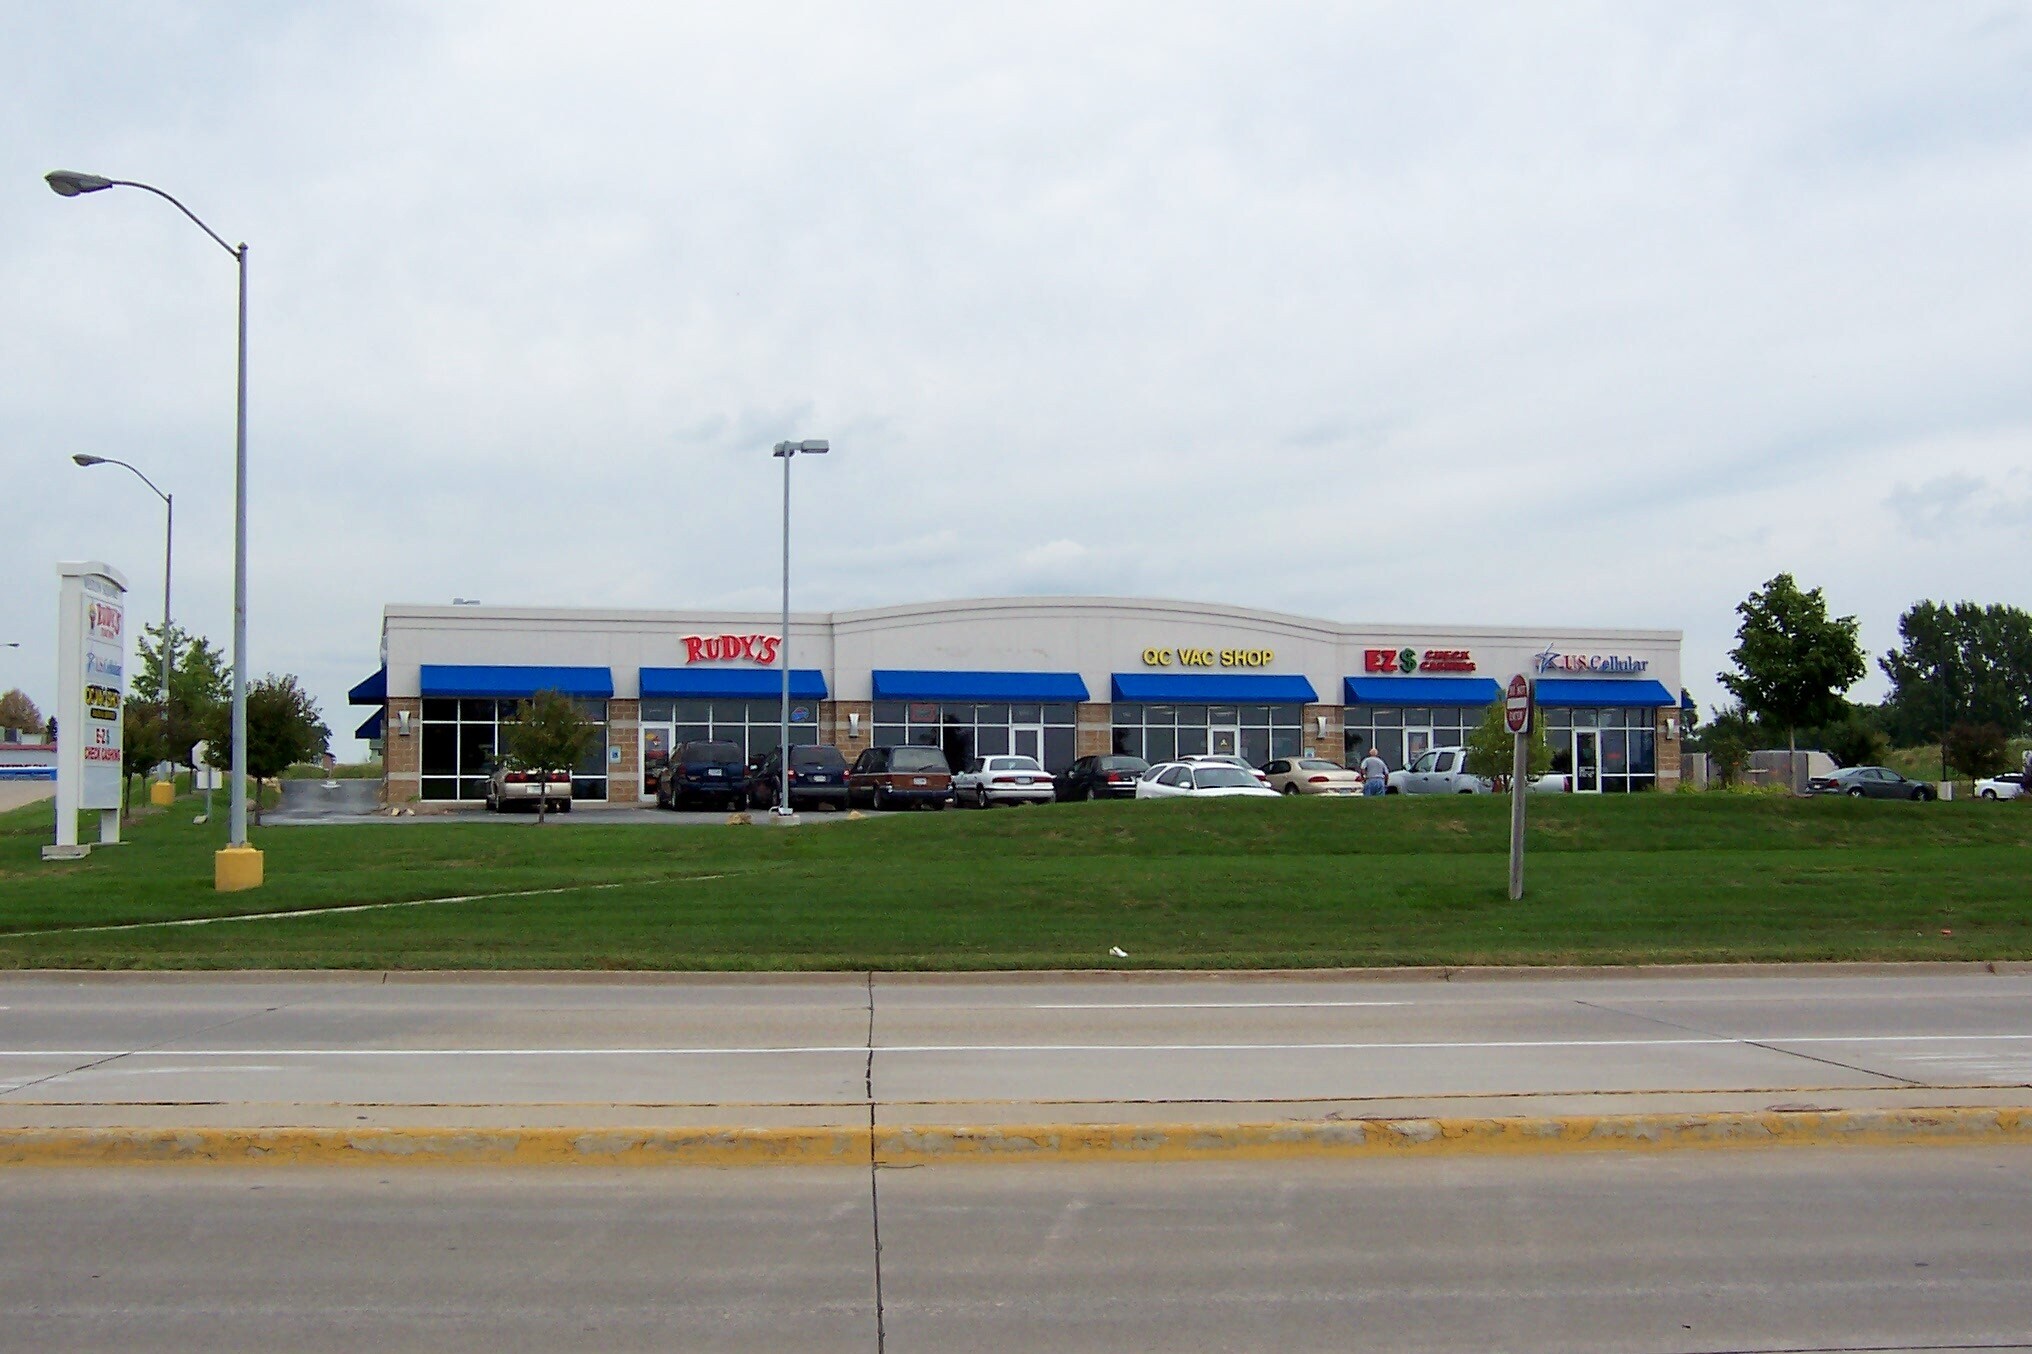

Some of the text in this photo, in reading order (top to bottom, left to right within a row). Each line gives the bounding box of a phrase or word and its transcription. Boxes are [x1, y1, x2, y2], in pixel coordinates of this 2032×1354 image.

[681, 635, 782, 665] RUDY'S
[1142, 648, 1275, 668] QC VAC SHOP
[1590, 655, 1649, 672] Cellular
